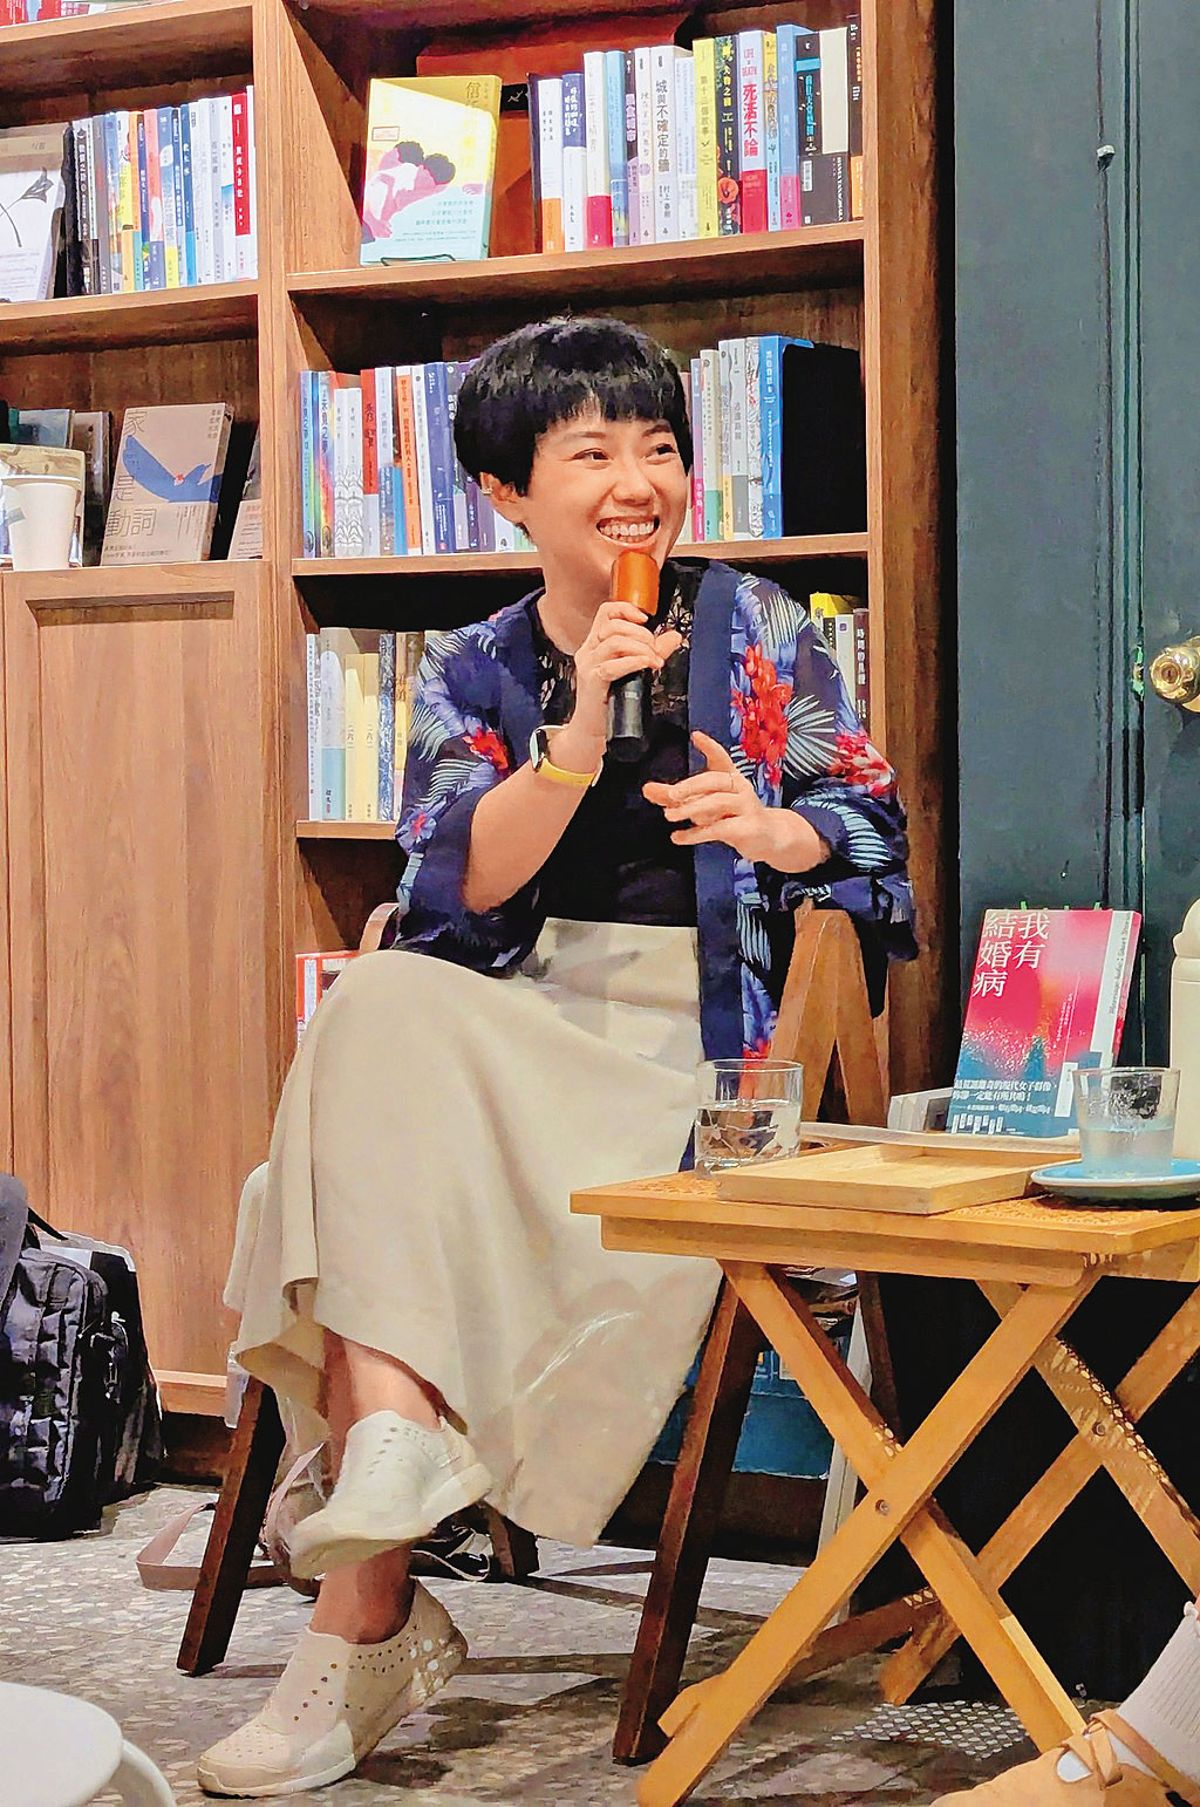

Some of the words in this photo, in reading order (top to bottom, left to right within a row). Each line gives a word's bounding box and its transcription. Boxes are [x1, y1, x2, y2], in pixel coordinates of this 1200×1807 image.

[743, 83, 758, 157] 死活不論
[105, 508, 157, 537] 動詞
[972, 912, 1017, 997] 結婚病
[1012, 911, 1050, 969] 我有
